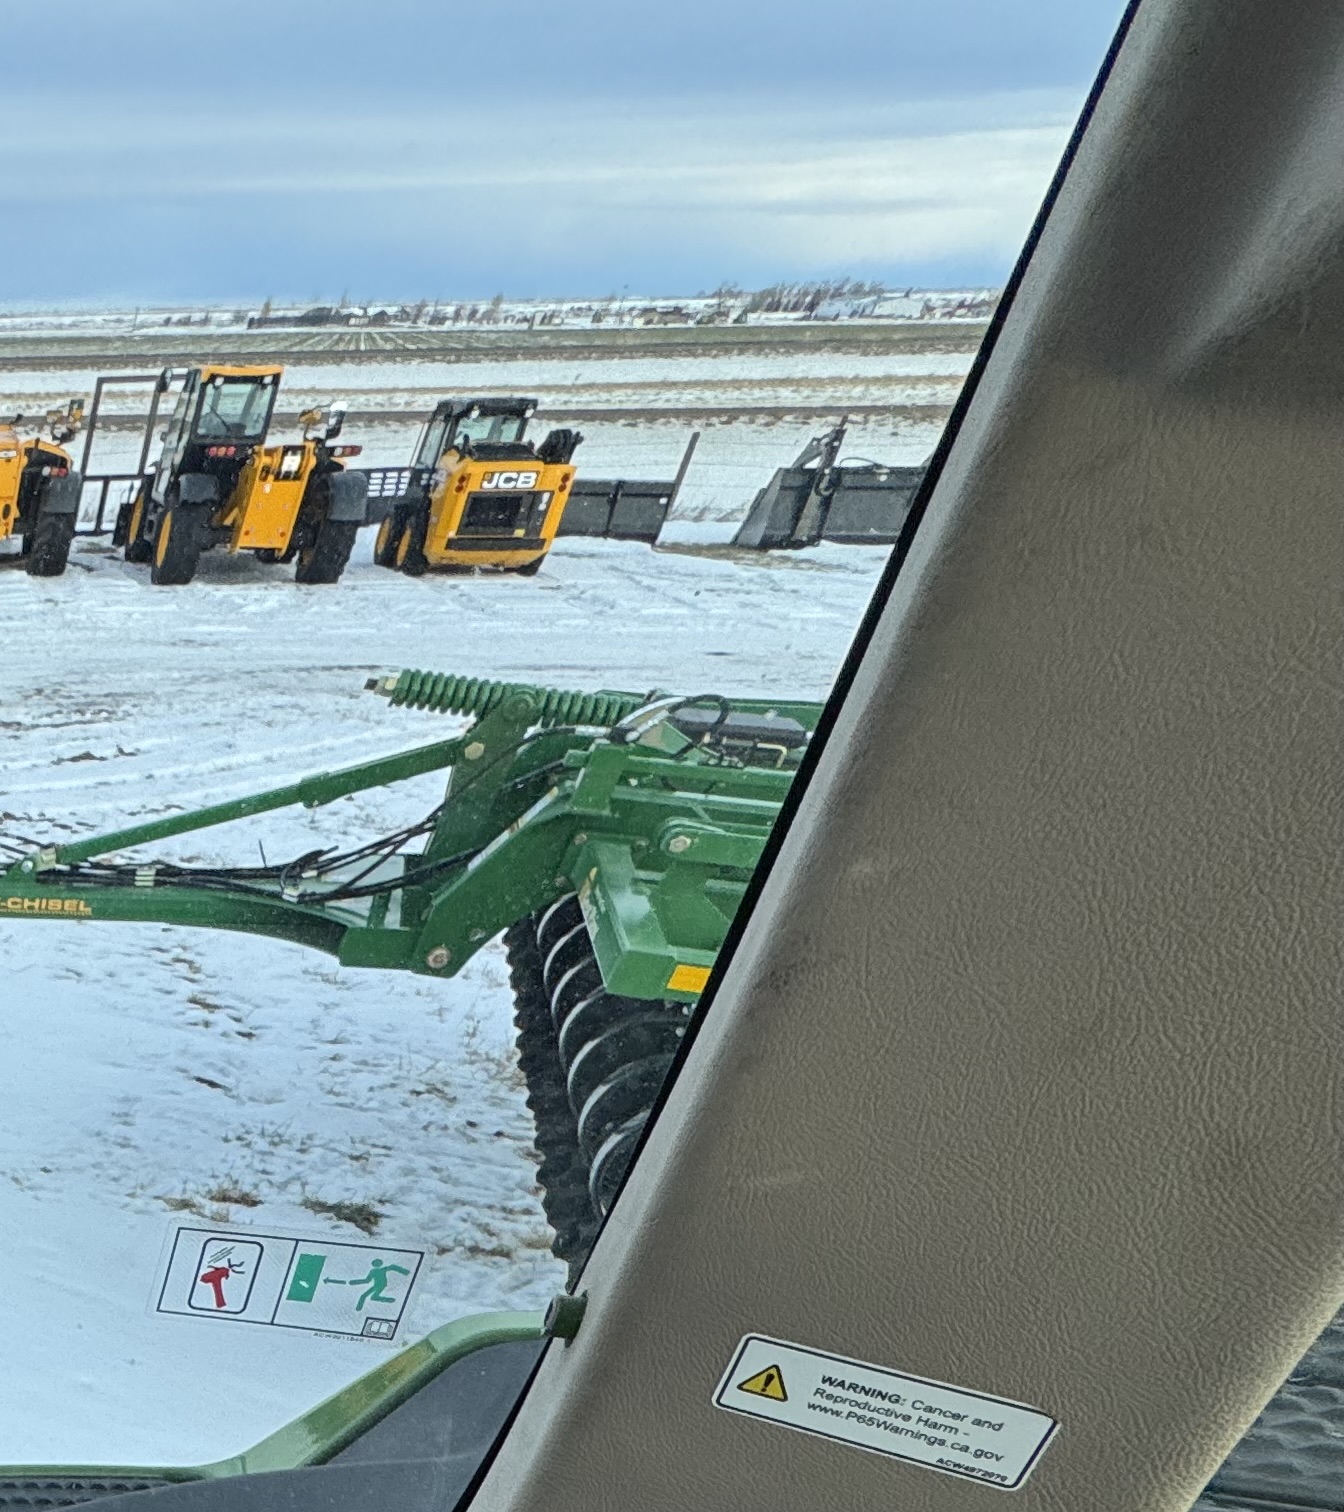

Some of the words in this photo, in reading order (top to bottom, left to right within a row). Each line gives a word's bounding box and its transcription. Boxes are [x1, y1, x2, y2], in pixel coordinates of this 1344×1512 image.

[481, 471, 539, 489] JCB
[813, 1387, 913, 1423] Reproductive
[915, 1414, 960, 1436] Harm
[820, 1373, 908, 1407] WARNING:
[910, 1398, 970, 1423] Cancer
[970, 1415, 1006, 1433] and
[806, 1400, 1007, 1463] www.P65Warnings.ca.gov
